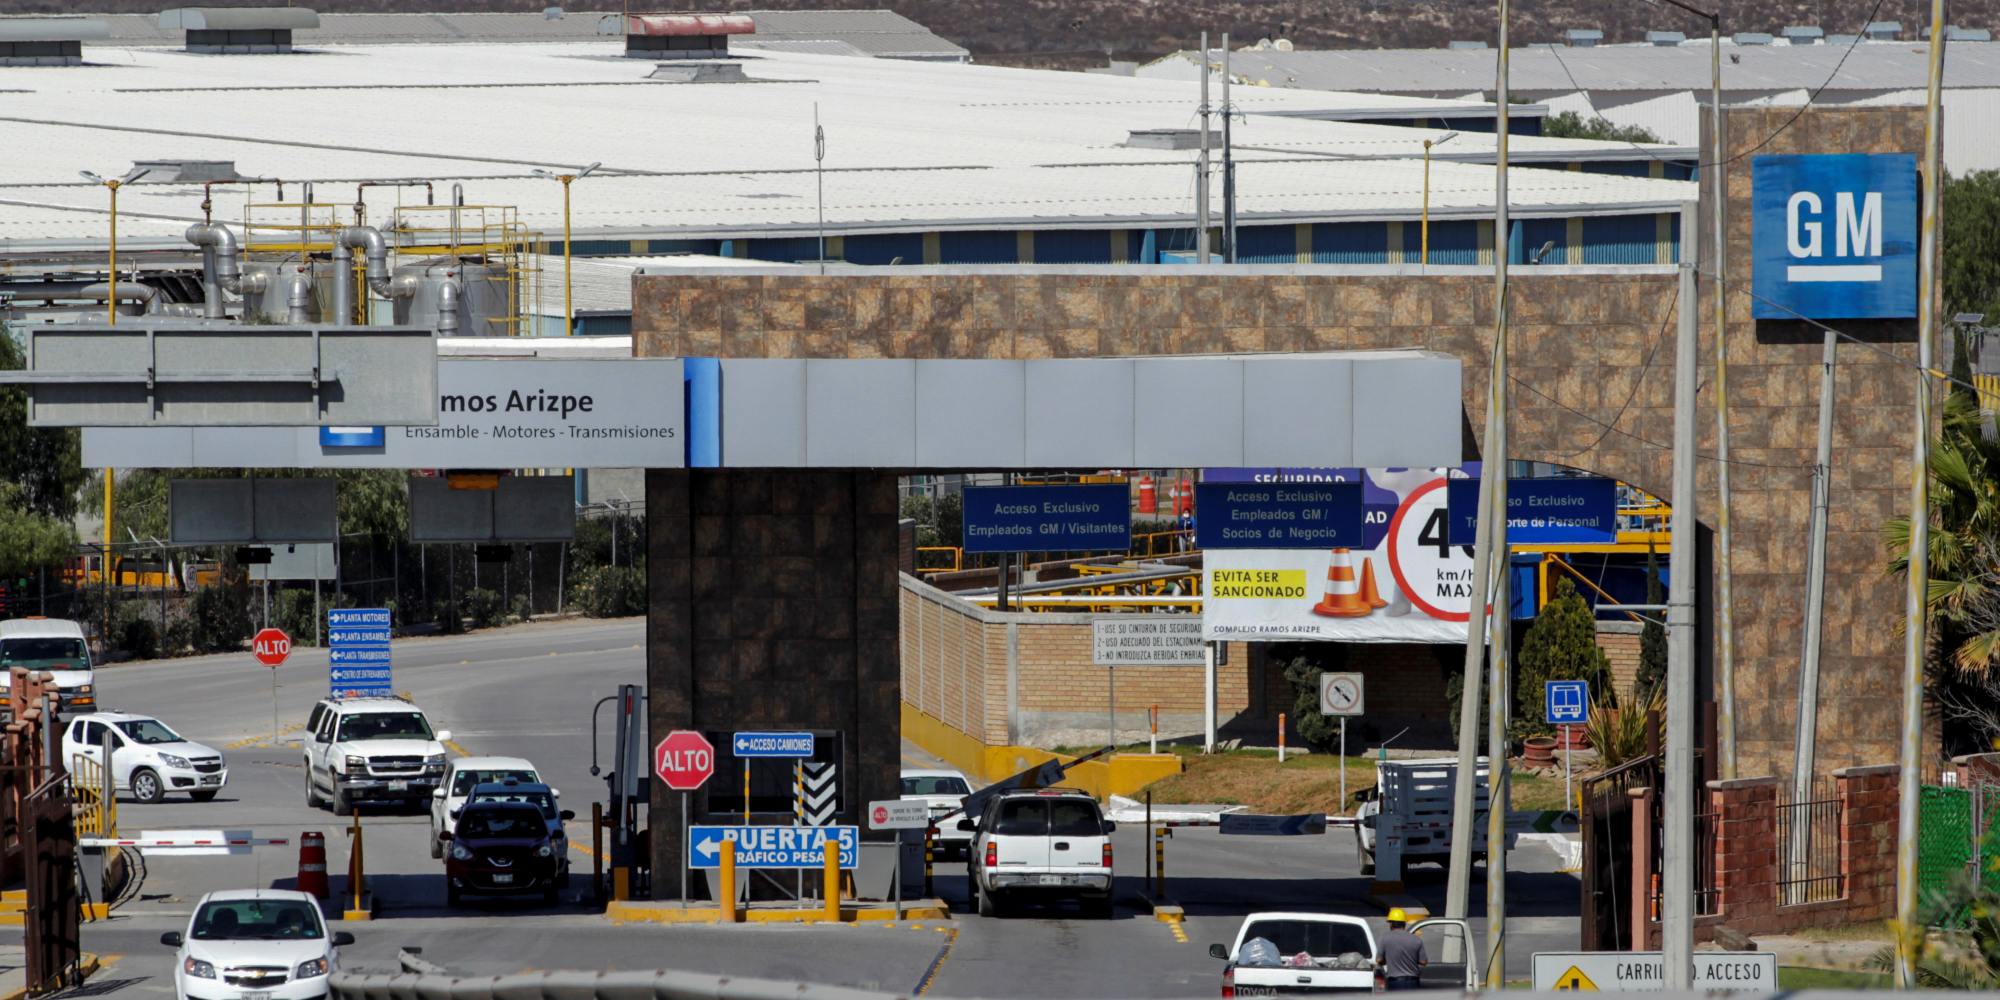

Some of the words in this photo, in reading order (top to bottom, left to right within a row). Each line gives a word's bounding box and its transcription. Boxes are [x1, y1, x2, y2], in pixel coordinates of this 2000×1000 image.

[1787, 190, 1882, 258] GM
[440, 394, 497, 412] mos
[505, 389, 593, 419] Arizpe
[405, 425, 479, 438] Ensamble
[493, 426, 555, 438] Motores
[568, 426, 675, 438] Transmisiones
[1227, 491, 1270, 502] Acceso
[1276, 490, 1333, 502] Exclusivo
[1528, 495, 1585, 506] Exclusivo
[994, 503, 1037, 515] Acceso
[1043, 502, 1100, 513] Exclusivo
[1231, 509, 1296, 522] Empleados
[1302, 509, 1321, 520] GM
[1364, 511, 1388, 524] AD
[1465, 516, 1529, 528] Trorte
[1531, 516, 1545, 528] de
[1548, 515, 1600, 528] Personal
[968, 525, 1033, 538] Empleados
[1039, 523, 1059, 534] GM
[1068, 522, 1125, 534] Visitantes
[1222, 527, 1262, 538] Socios
[1268, 527, 1283, 538] de
[1289, 526, 1337, 540] Negocio
[1213, 571, 1252, 582] EVITA
[1256, 571, 1279, 582] SER
[1213, 586, 1305, 597] SANCIONADO
[340, 613, 361, 623] PLANTA
[1119, 623, 1126, 634] SU
[1160, 623, 1167, 634] DE
[1170, 623, 1202, 634] SEGURIDAD
[1213, 625, 1257, 633] COMPLEJO
[1259, 625, 1290, 633] RAMOS
[1292, 625, 1321, 633] ARIZPE
[341, 632, 361, 642] PLANTA
[1120, 636, 1151, 647] ADECUADO
[1153, 636, 1164, 647] DEL
[1166, 636, 1202, 647] ESTACIONAM
[256, 640, 289, 655] ALTO
[1116, 650, 1152, 661] INTRODUZCA
[1154, 650, 1179, 660] BEBIDAS
[1181, 650, 1206, 660] EMBRIAG
[750, 738, 777, 750] ACCESO
[777, 738, 811, 750] CAMIONES
[661, 750, 709, 772] ALTO
[723, 829, 829, 850] PUERTA
[838, 829, 853, 850] 5
[735, 850, 788, 863] RÁFICO
[793, 851, 853, 865] PESAO)
[1707, 963, 1761, 980] ACCESO
[1237, 986, 1278, 998] TOYOTA
